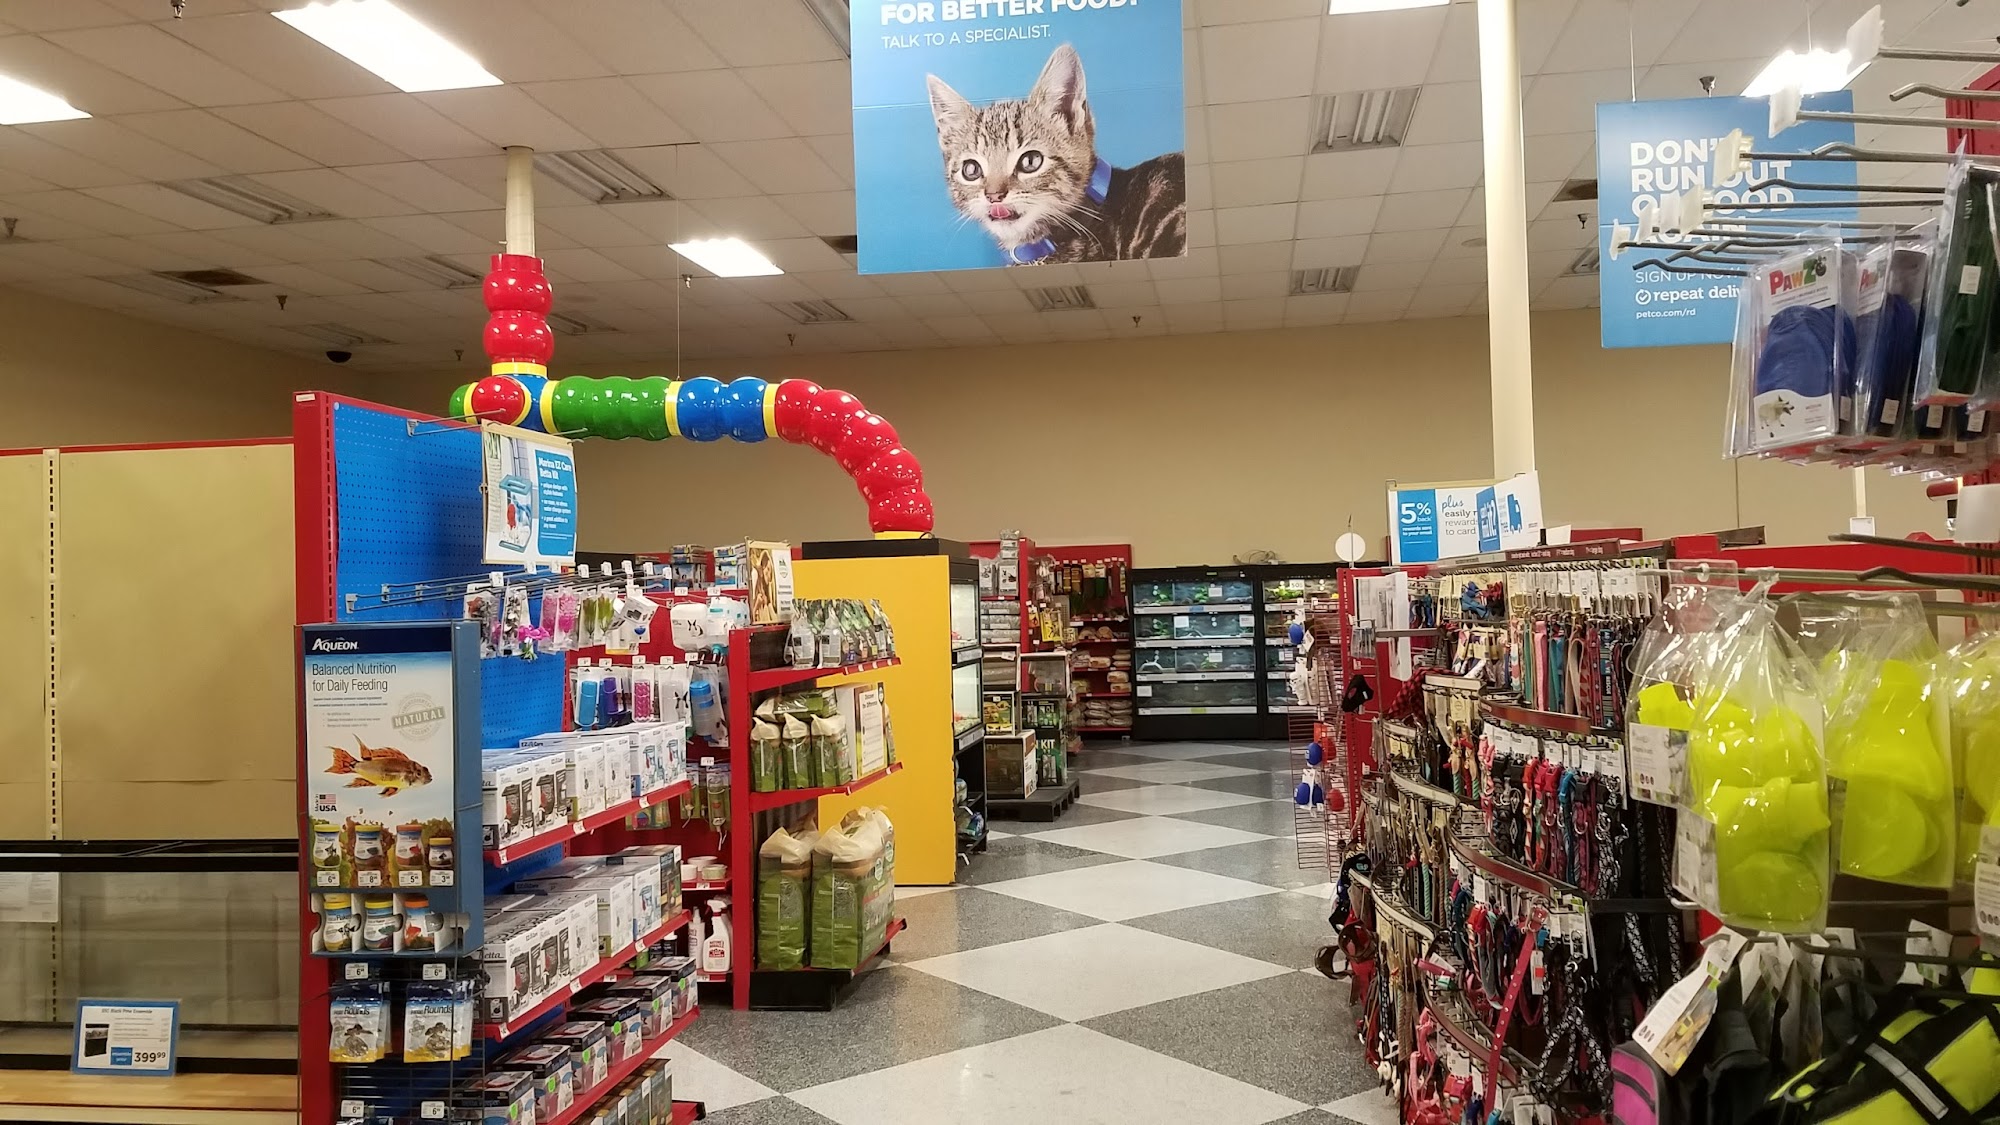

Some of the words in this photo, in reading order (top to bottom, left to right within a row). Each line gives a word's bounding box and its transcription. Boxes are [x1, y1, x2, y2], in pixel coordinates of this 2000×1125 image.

[880, 2, 936, 26] FOR
[941, 0, 1045, 21] BETTER
[1051, 0, 1138, 12] FOO
[881, 34, 919, 49] TALK
[924, 33, 945, 47] TO
[949, 31, 961, 45] A
[965, 24, 1052, 43] SPECIALIST.
[1631, 138, 1724, 166] DON'
[1632, 165, 1705, 193] RUN
[1711, 187, 1794, 215] OOD
[1635, 270, 1671, 283] SIGN
[1653, 287, 1704, 304] repeat
[1636, 308, 1696, 320] petco.com/rd
[1442, 495, 1464, 513] plus
[1445, 509, 1471, 518] easily
[1446, 528, 1455, 536] to
[1457, 527, 1477, 535] card
[312, 638, 358, 652] AQUEON
[312, 663, 354, 675] Balanced
[356, 663, 397, 675] Nutrition
[312, 680, 324, 691] for
[327, 679, 349, 693] Daily
[352, 679, 388, 692] Feeding
[394, 708, 443, 727] NATURAL
[1041, 739, 1055, 749] KIT
[343, 1006, 370, 1015] Rounds
[423, 1004, 453, 1014] Rounds
